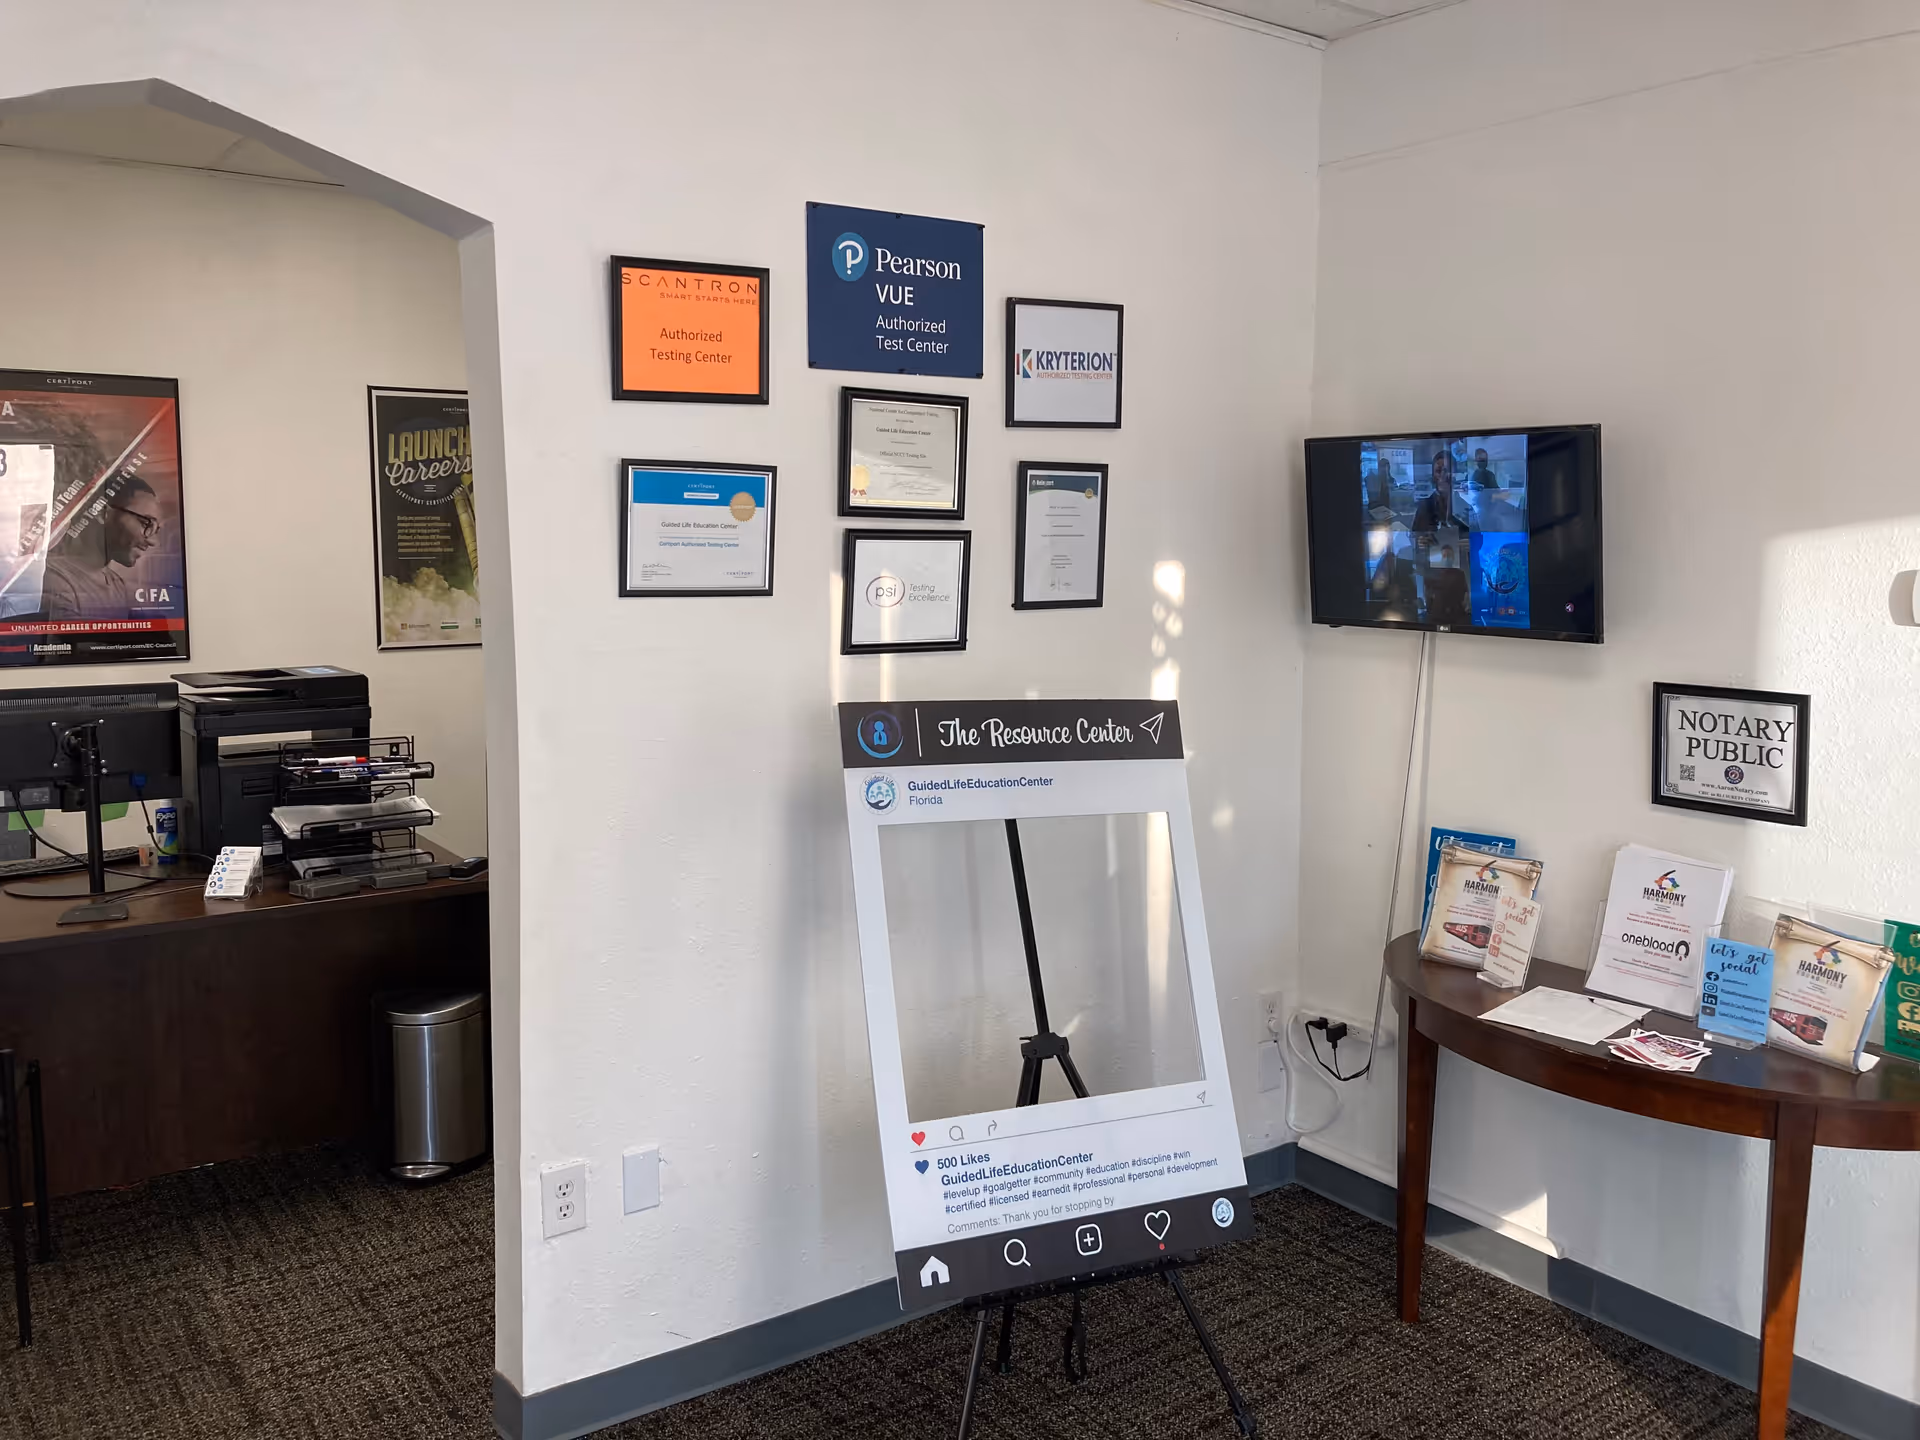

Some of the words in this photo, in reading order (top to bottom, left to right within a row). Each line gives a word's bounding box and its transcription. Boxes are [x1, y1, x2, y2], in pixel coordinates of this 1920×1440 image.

[874, 247, 962, 281] Pearson
[621, 272, 758, 295] SCANTRON
[659, 292, 693, 301] SMART
[695, 295, 730, 304] STARTS
[732, 297, 757, 306] HERE
[875, 283, 914, 306] VUE
[876, 314, 946, 333] Authorized
[660, 327, 723, 343] Authorized
[876, 335, 904, 352] Test
[907, 337, 949, 354] Center
[650, 348, 692, 365] Testing
[695, 350, 733, 364] Center
[1036, 350, 1113, 372] KRYTERION
[46, 377, 93, 386] CERTIPORT
[1036, 372, 1071, 380] AUTHORIZED
[1072, 372, 1093, 380] TESTING
[1093, 372, 1113, 380] CENTER
[388, 424, 472, 464] LAUNCH
[385, 456, 472, 487] Careers
[56, 479, 85, 504] Team
[67, 517, 89, 539] Blue
[84, 495, 108, 519] Team
[875, 584, 897, 601] psi
[909, 583, 936, 594] Testing
[908, 593, 951, 602] Excellence
[11, 624, 59, 633] UNLIMITED
[60, 623, 91, 632] CAREER
[92, 621, 152, 631] OPPORTUNITIES
[33, 643, 72, 652] Academia
[937, 717, 981, 748] The
[981, 717, 1073, 748] Resource
[1076, 717, 1134, 745] Center
[1678, 709, 1795, 743] NOTARY
[1685, 736, 1784, 769] PUBLIC
[908, 776, 1054, 792] GuidedLifeEducationCenter
[1701, 782, 1769, 796] www.AaronNotary.com
[909, 794, 943, 806] Florida
[156, 812, 176, 823] EXPO
[1643, 886, 1687, 903] HARMONY
[1504, 911, 1528, 926] social
[1519, 904, 1536, 918] get
[1621, 932, 1675, 954] oneblood
[1745, 951, 1775, 966] get
[1720, 961, 1760, 976] social
[1798, 959, 1848, 984] HARMONY
[937, 1156, 957, 1170] 500
[960, 1153, 991, 1167] Likes
[941, 1152, 1094, 1186] GuidedLifeEducationCenter
[943, 1187, 981, 1201] #levelup
[983, 1177, 1032, 1195] #goalgetter
[1033, 1167, 1084, 1184] #community
[1086, 1160, 1130, 1176] #education
[1131, 1153, 1172, 1168] #discipline
[1173, 1149, 1191, 1161] #win
[945, 1198, 987, 1214] #certified
[988, 1190, 1030, 1206] #licensed
[1032, 1182, 1071, 1199] #earnedit
[1072, 1174, 1126, 1193] #professional
[1127, 1166, 1165, 1183] #personal
[1166, 1157, 1218, 1174] #development
[947, 1217, 1001, 1234] Comments:
[1002, 1209, 1032, 1224] Thank
[1033, 1208, 1049, 1220] you
[1051, 1203, 1063, 1215] for
[1065, 1197, 1102, 1213] stopping
[1104, 1195, 1115, 1206] by
